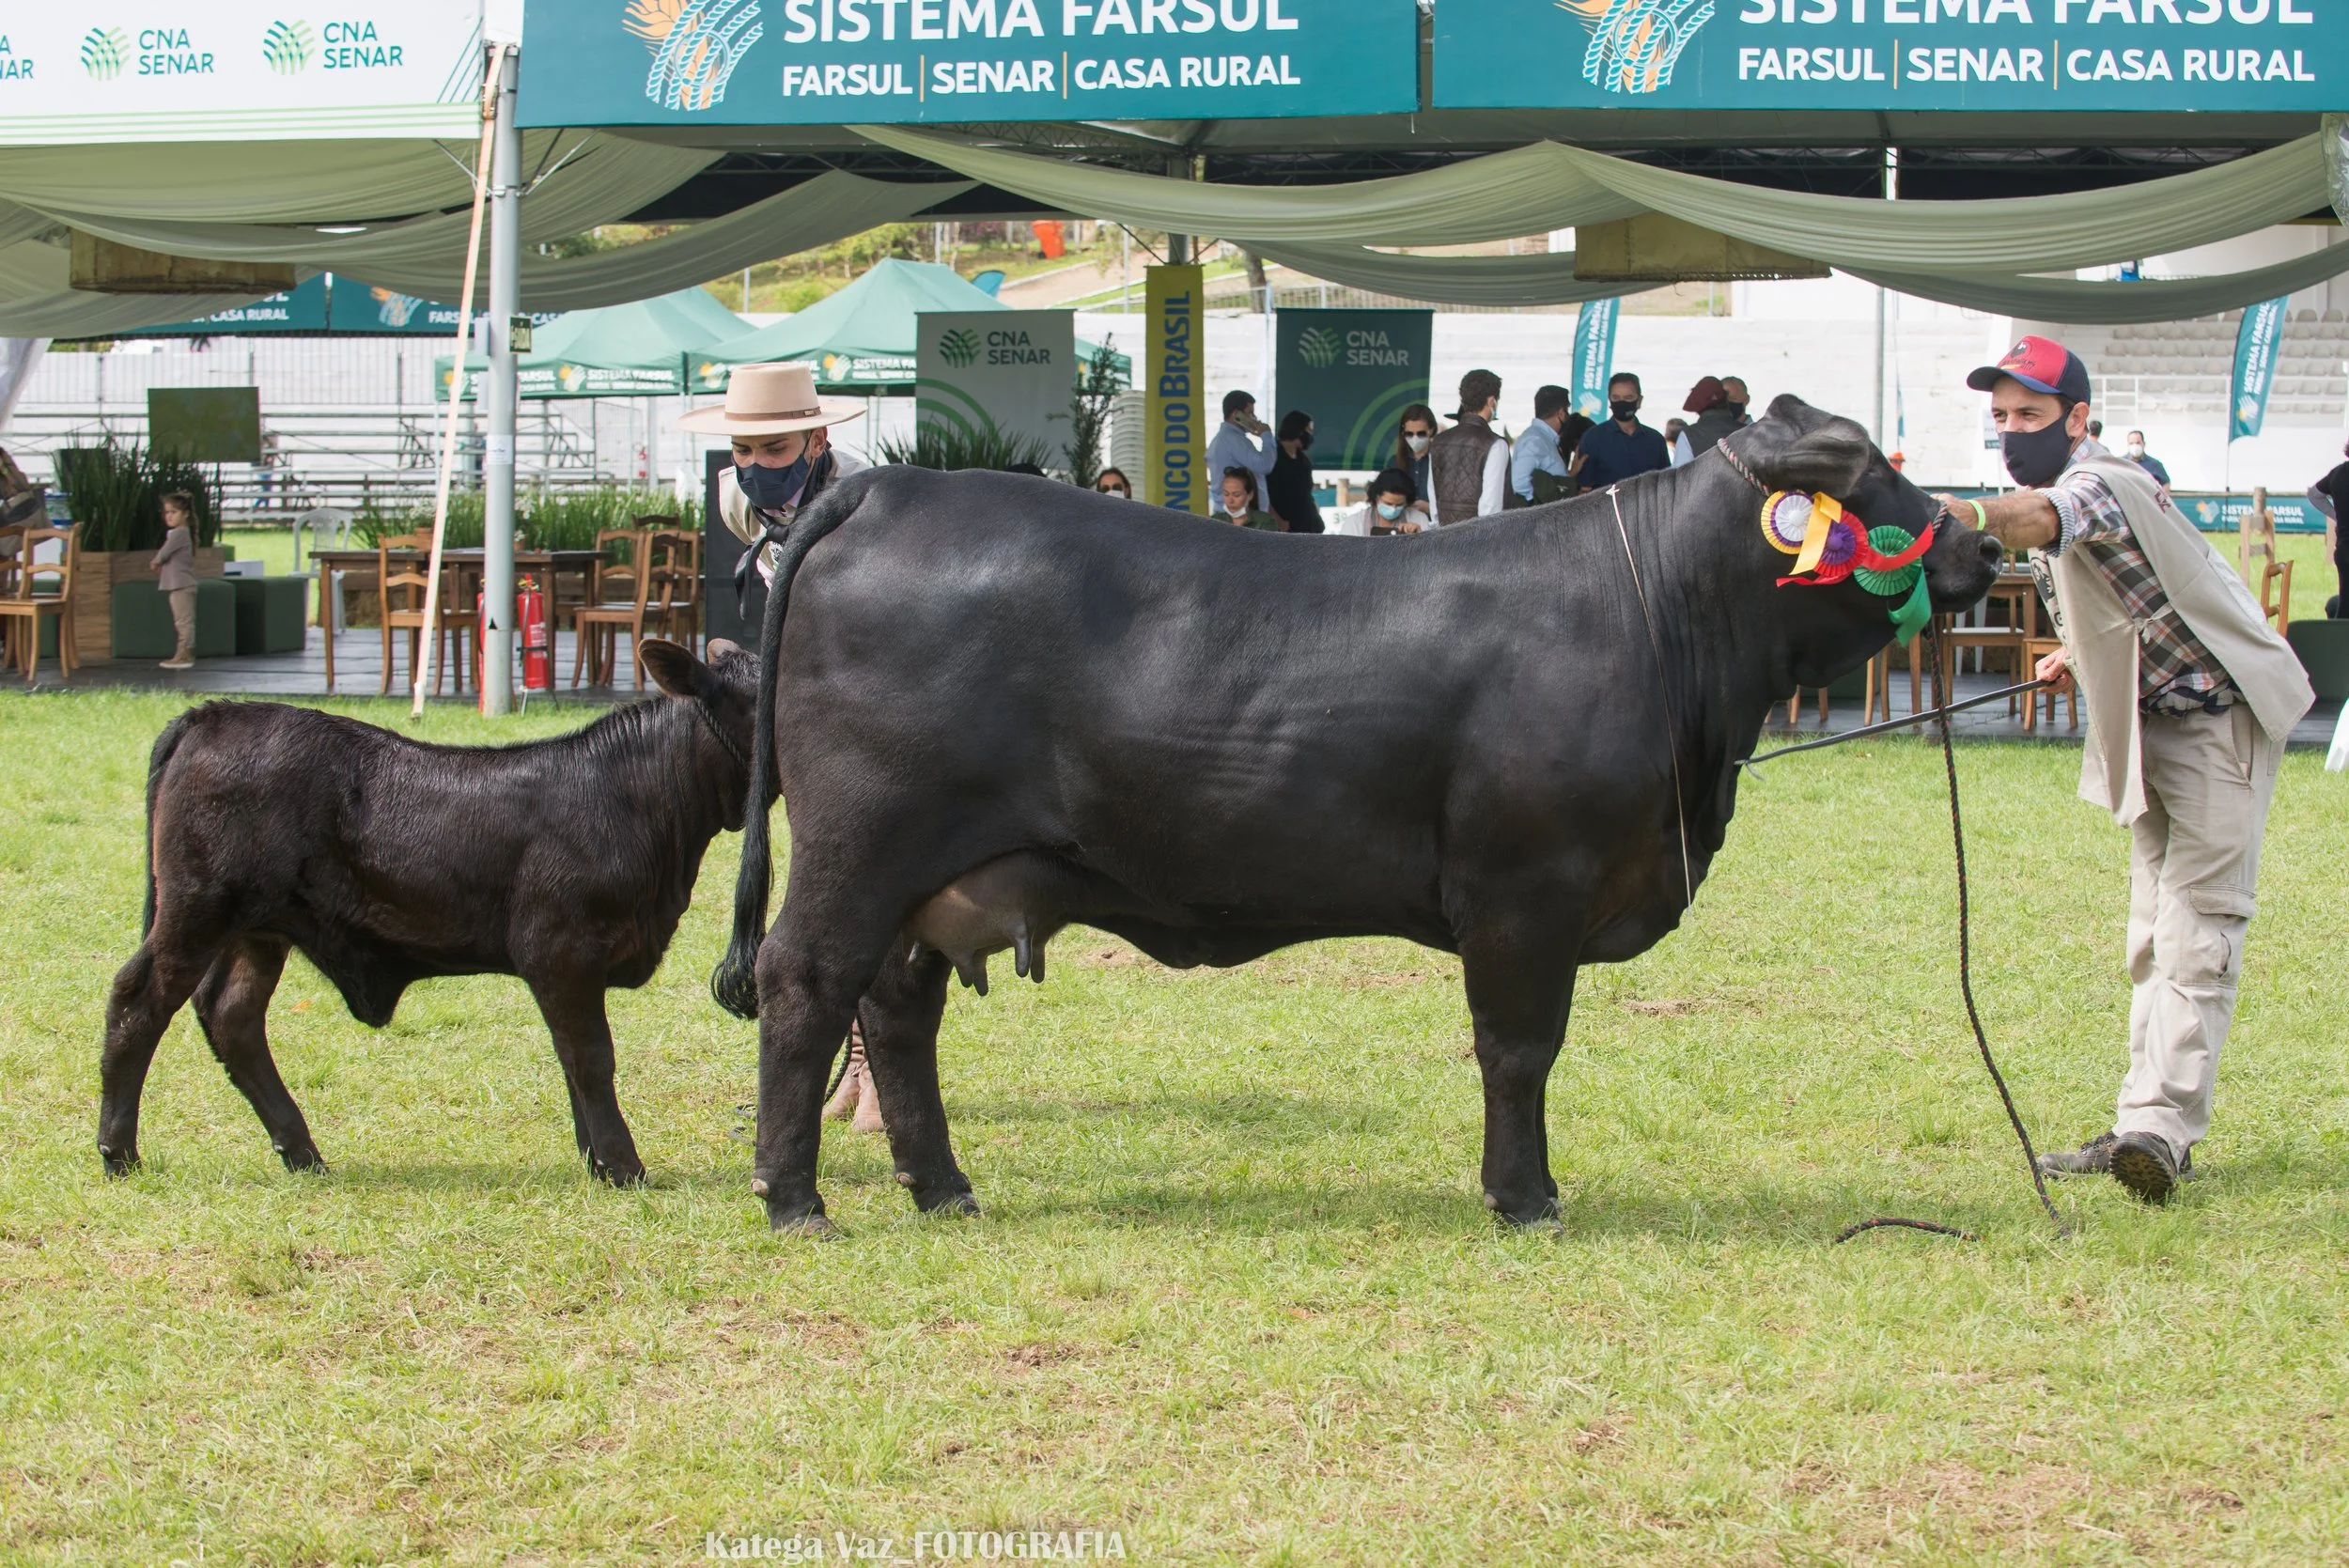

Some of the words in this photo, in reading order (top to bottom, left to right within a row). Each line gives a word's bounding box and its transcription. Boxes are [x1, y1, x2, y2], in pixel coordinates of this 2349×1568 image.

[323, 21, 378, 44] CNA
[784, 0, 1044, 43] SISTEMA
[1063, 0, 1299, 36] FARSUL
[138, 28, 191, 50] CNA
[138, 53, 214, 75] SENAR
[323, 45, 404, 70] SENAR
[1738, 47, 1886, 82] FARSUL
[1906, 48, 2045, 82] SENAR
[2066, 49, 2173, 82] CASA
[2183, 50, 2315, 82] RURAL
[783, 64, 912, 97] FARSUL
[931, 60, 1054, 95] SENAR
[1074, 56, 1172, 90] CASA
[1179, 54, 1301, 88] RURAL
[988, 331, 1031, 347] CNA
[1159, 290, 1191, 398] BRASIL
[1346, 331, 1391, 348] CNA
[988, 349, 1050, 365] SENAR
[1346, 349, 1409, 366] SENAR
[1163, 402, 1191, 444] DO
[1163, 449, 1191, 511] NCO
